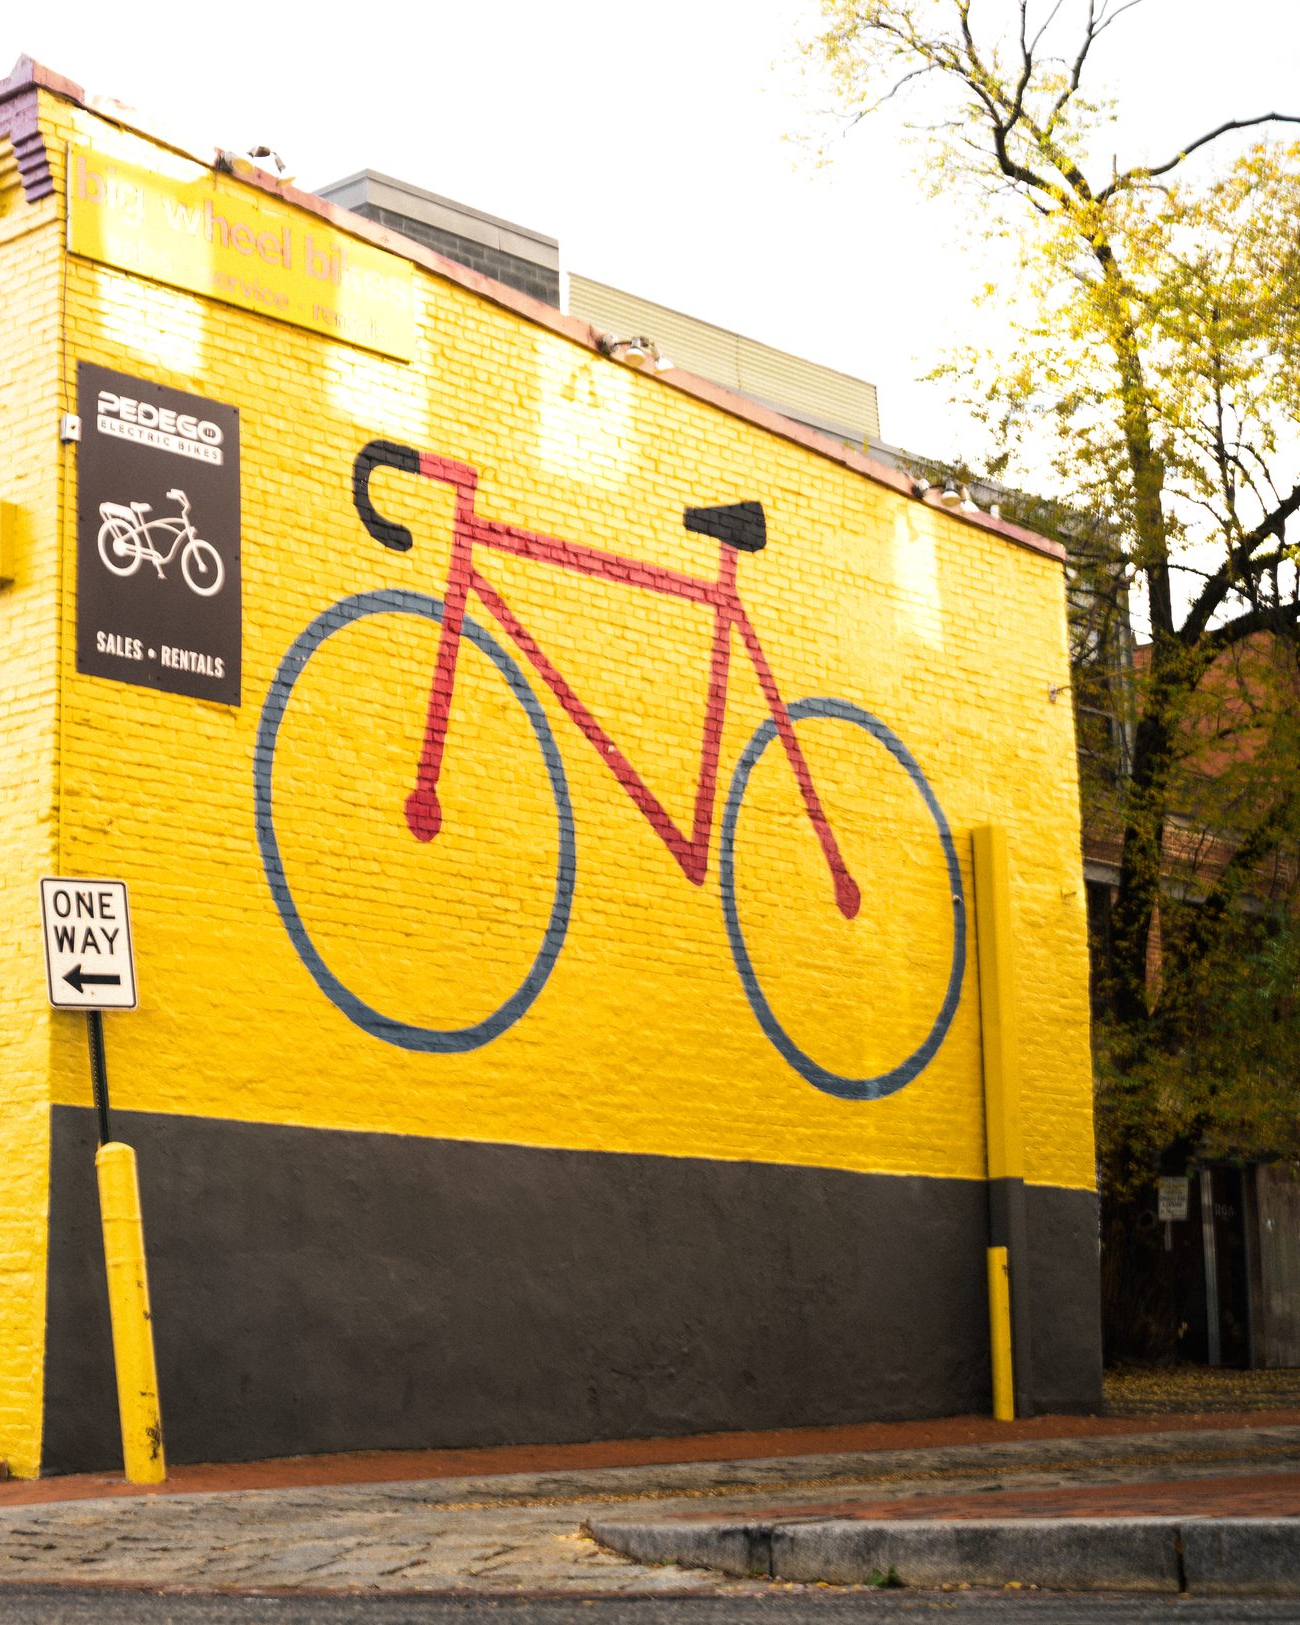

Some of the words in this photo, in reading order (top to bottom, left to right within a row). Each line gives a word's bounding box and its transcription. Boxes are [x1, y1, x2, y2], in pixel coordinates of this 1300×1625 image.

[161, 195, 292, 270] wheel
[97, 390, 224, 446] PEDEGO
[100, 419, 170, 446] ELECTRIC
[178, 439, 218, 460] BIKES
[96, 630, 144, 660] SALES
[161, 645, 225, 679] RENTALS
[52, 889, 116, 919] ONE
[53, 925, 120, 955] WAY
